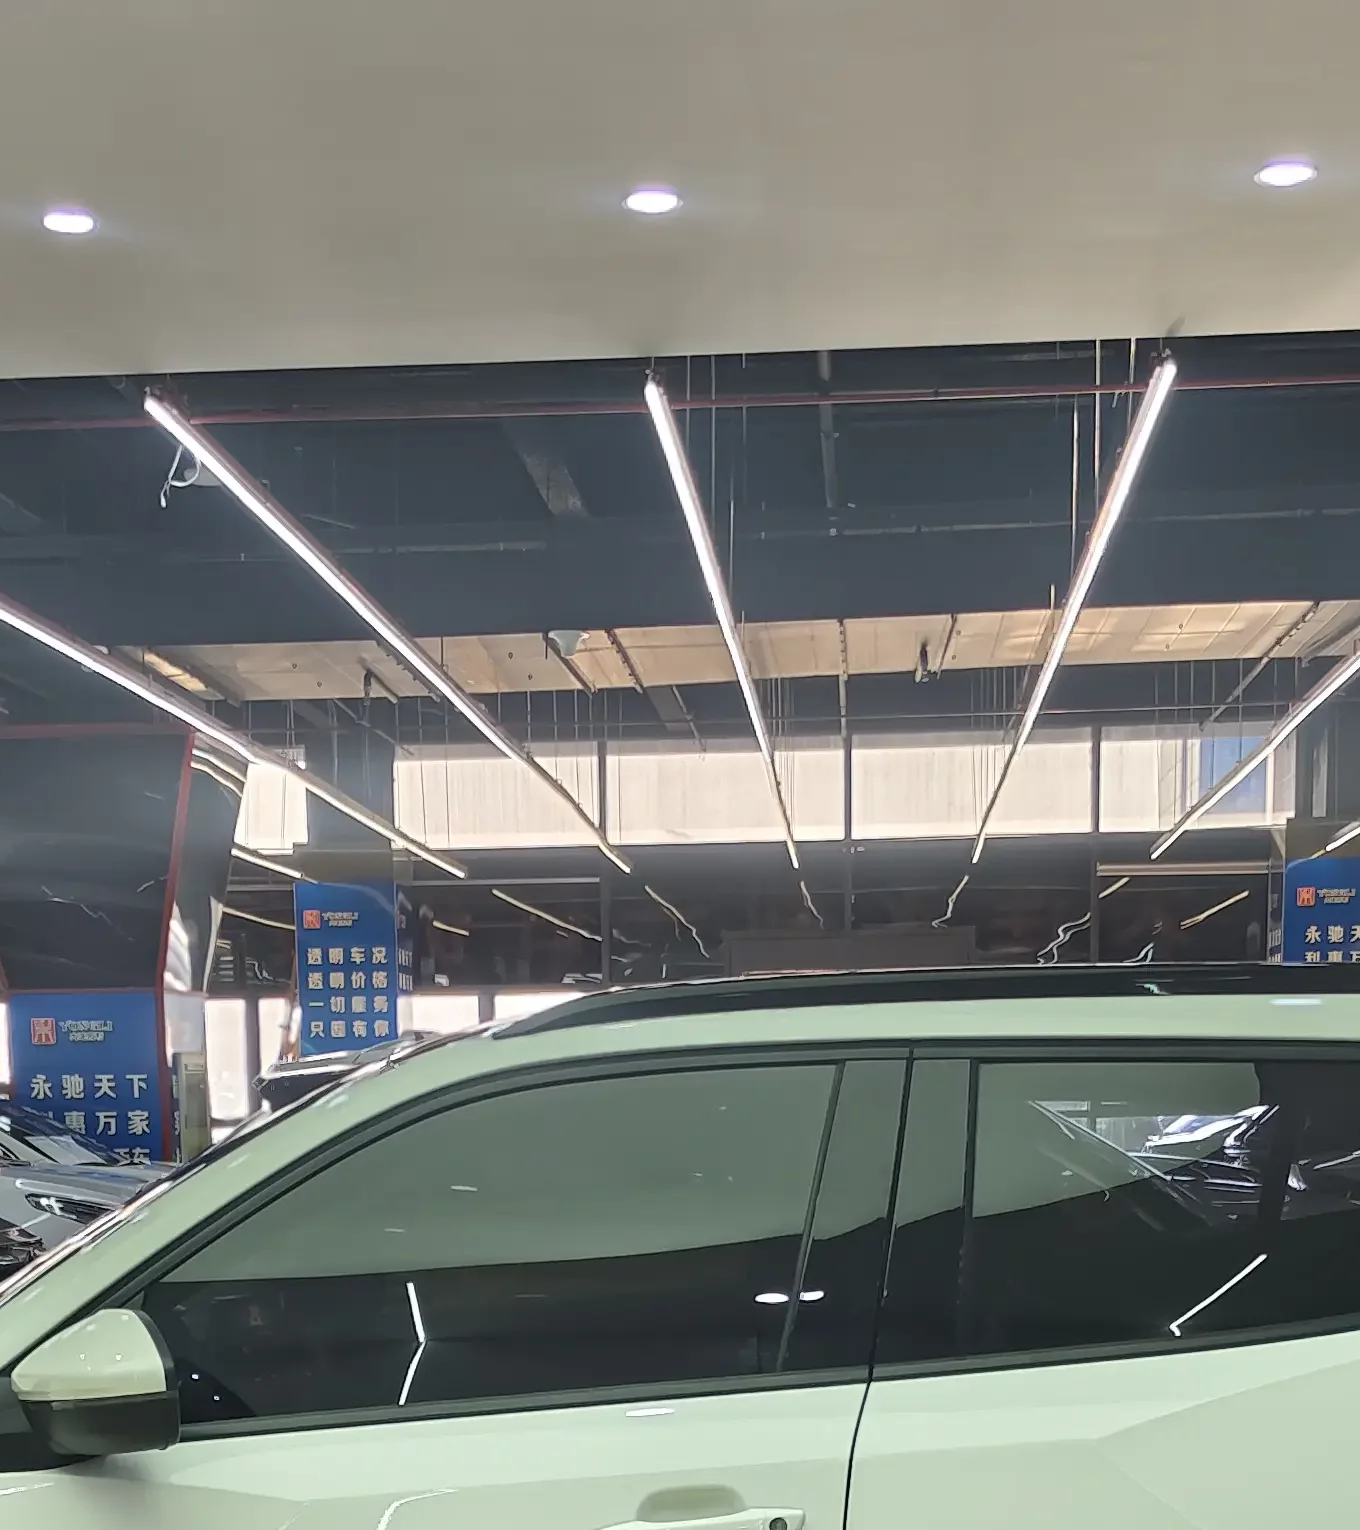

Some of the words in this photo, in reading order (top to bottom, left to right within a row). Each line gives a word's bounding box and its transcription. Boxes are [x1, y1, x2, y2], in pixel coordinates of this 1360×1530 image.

[30, 1074, 149, 1101] 永驰天下
[38, 1111, 151, 1136] 惠万家
